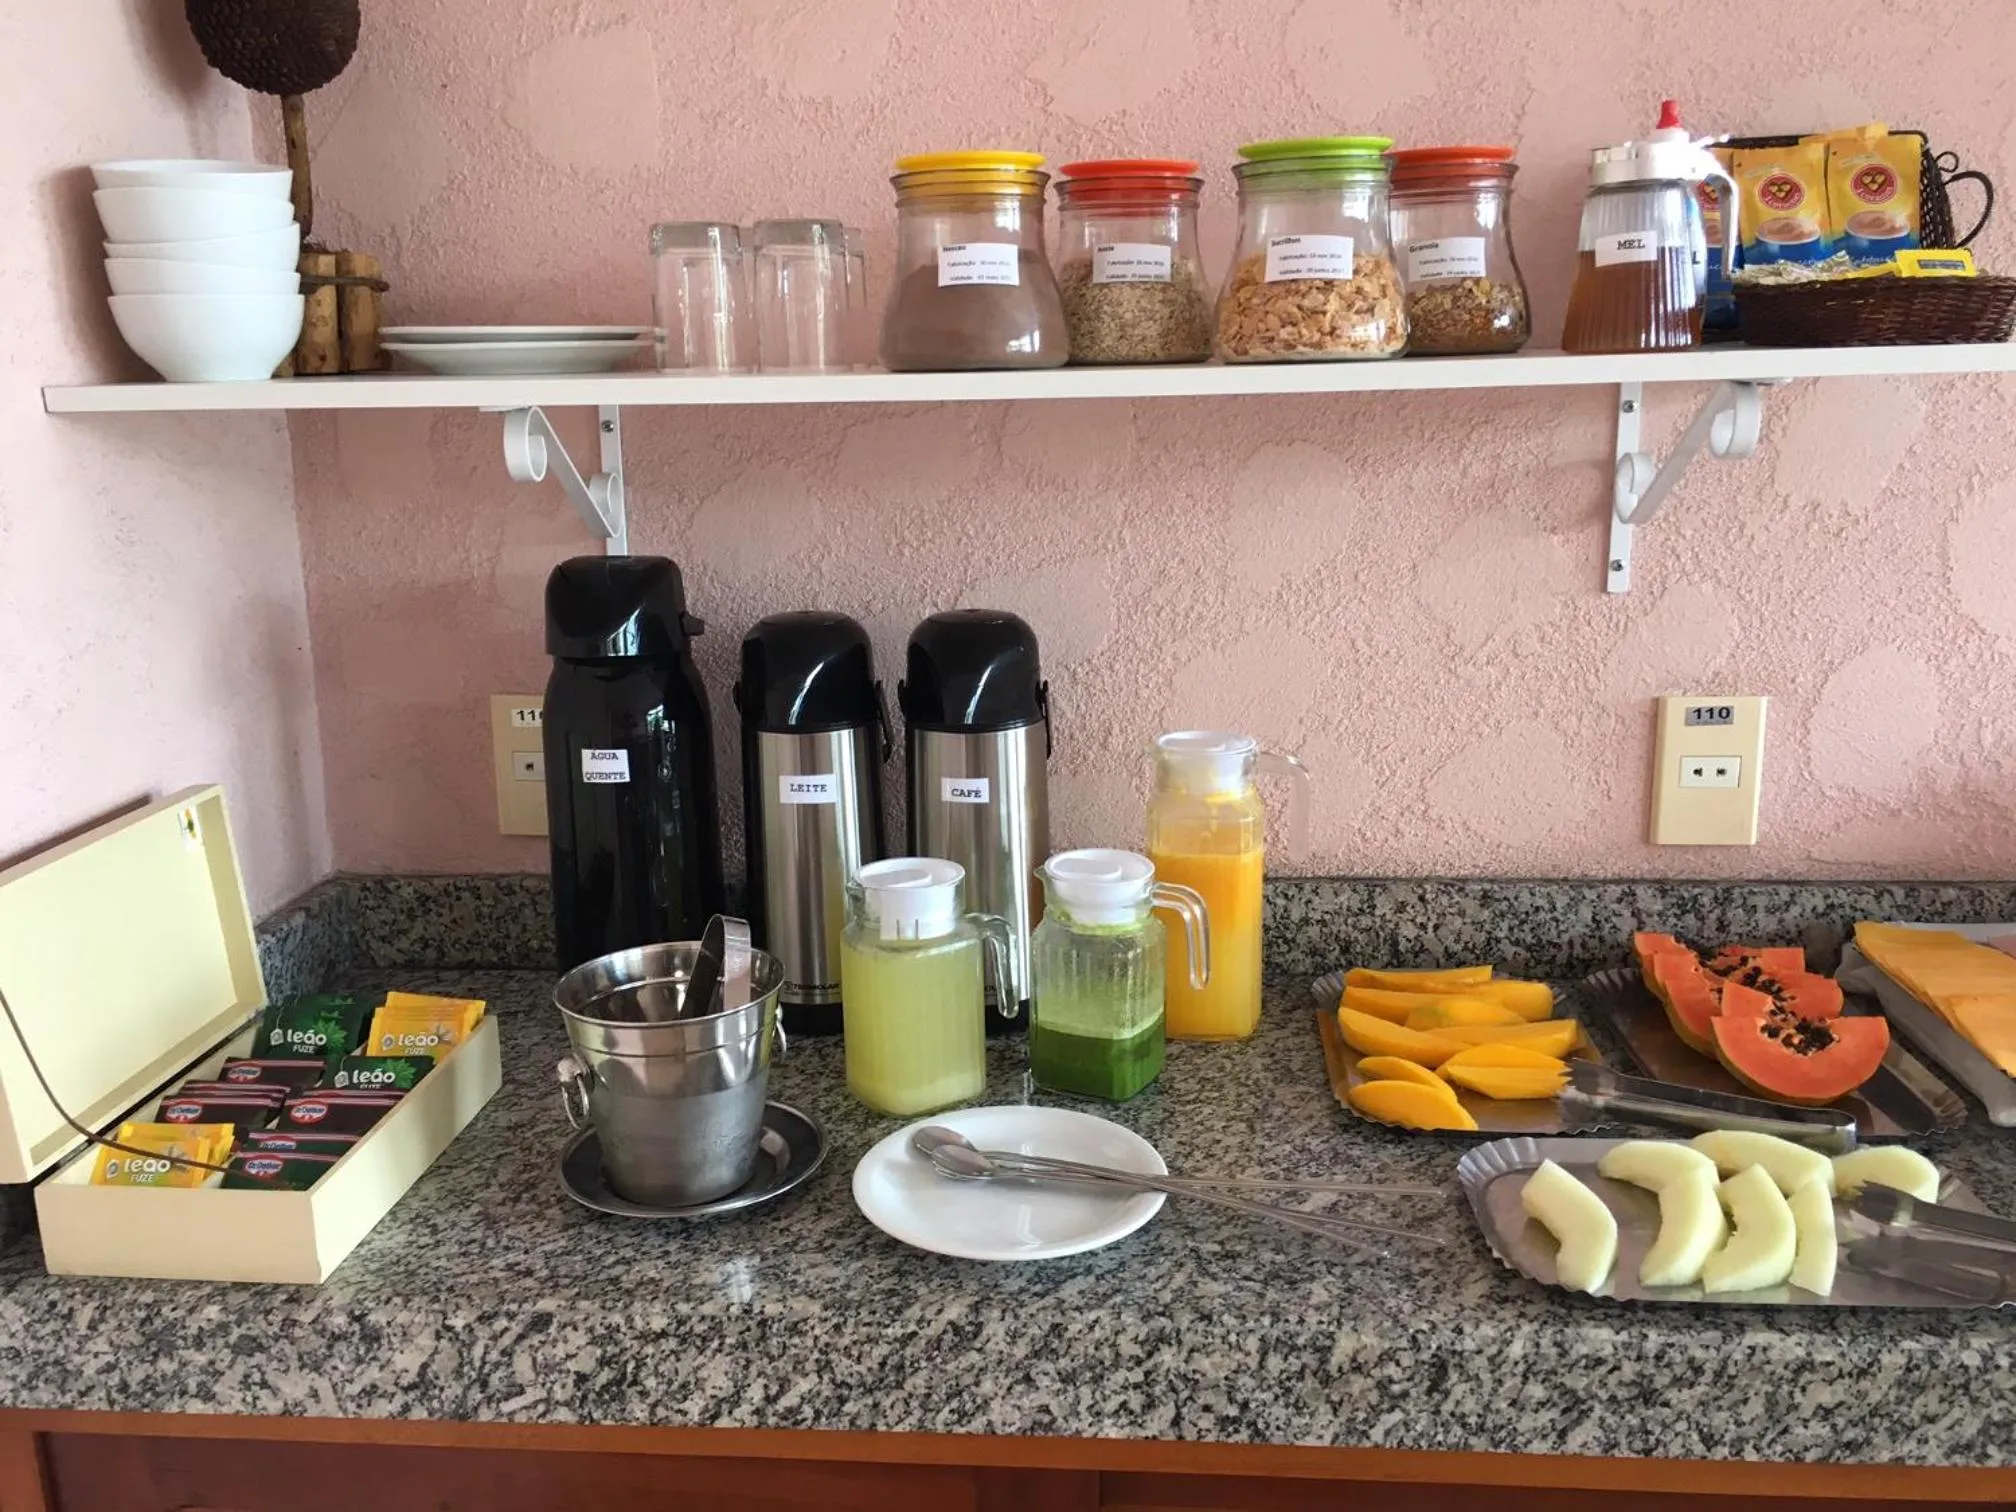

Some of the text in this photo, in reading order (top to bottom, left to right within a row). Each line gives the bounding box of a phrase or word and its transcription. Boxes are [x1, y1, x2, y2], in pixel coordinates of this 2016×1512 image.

[1617, 239, 1646, 250] MEL
[1693, 707, 1730, 719] 110
[585, 772, 626, 781] QUENTE
[790, 783, 827, 793] LEITE
[951, 787, 982, 798] CAFÉ
[293, 1045, 316, 1054] FUZE
[352, 1068, 396, 1083] leão
[131, 1173, 155, 1182] FUZE
